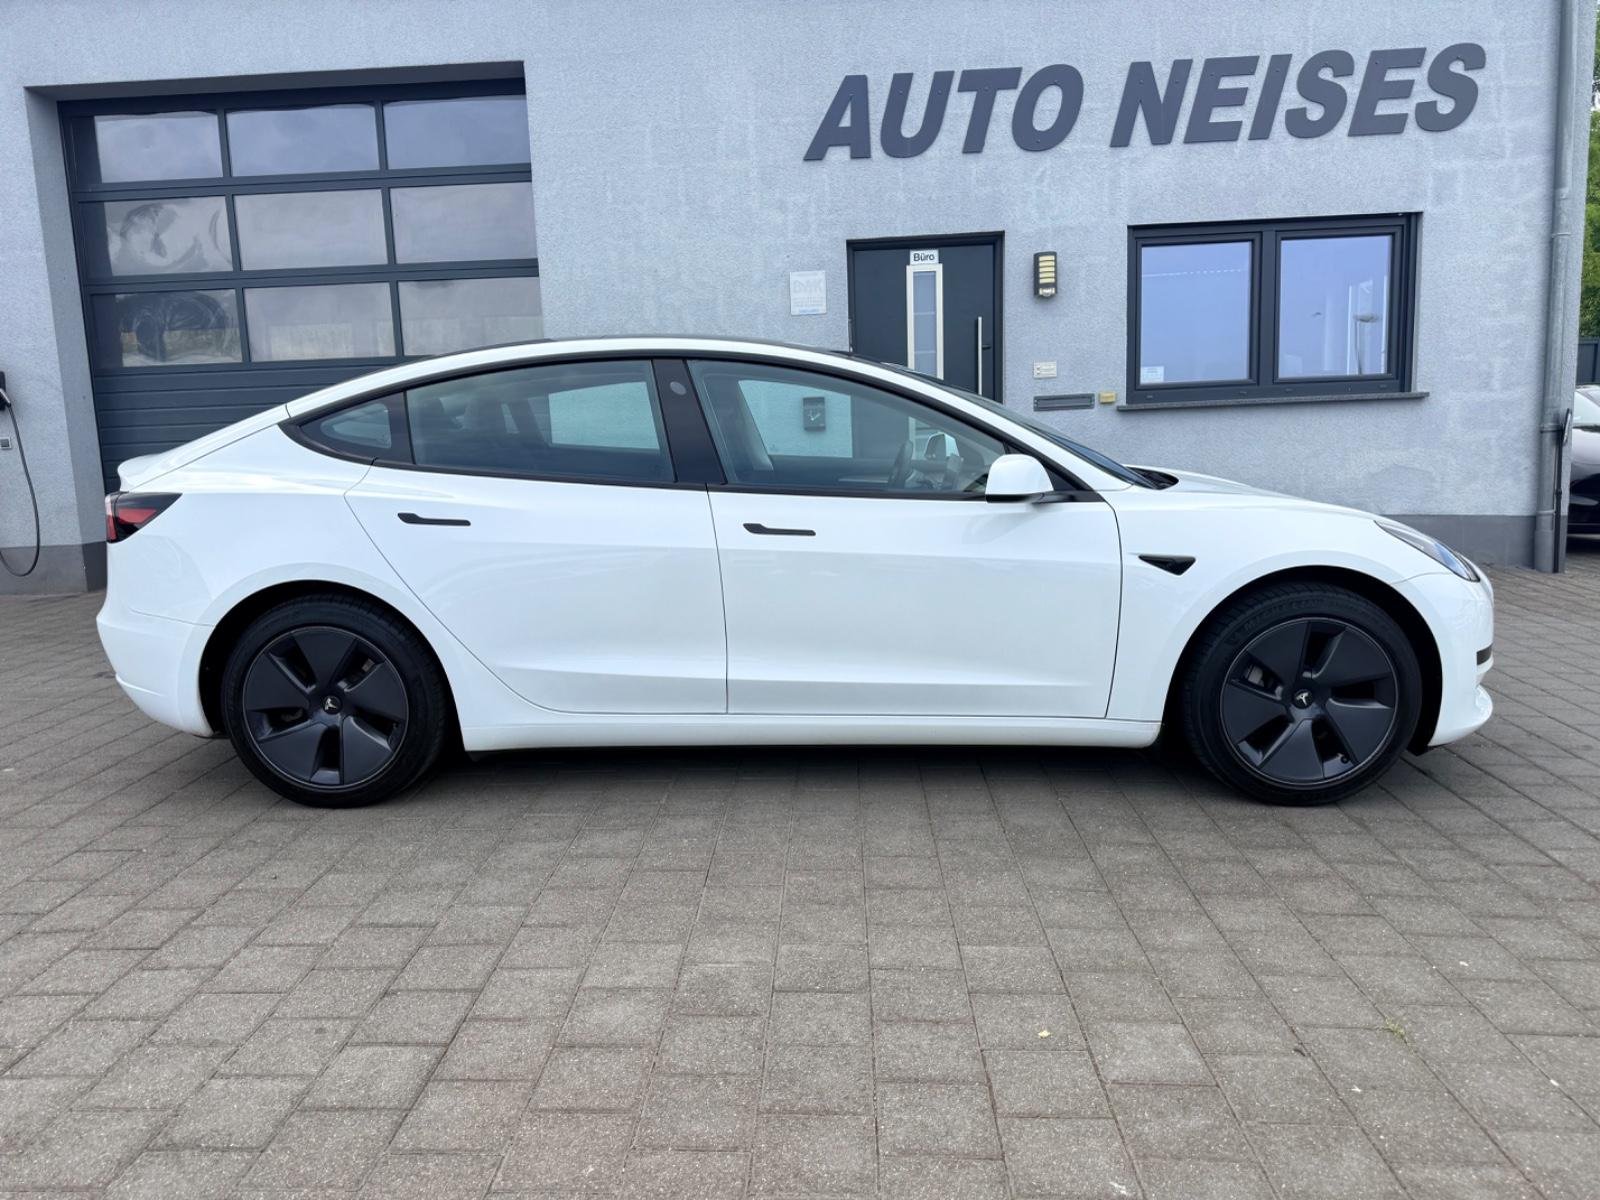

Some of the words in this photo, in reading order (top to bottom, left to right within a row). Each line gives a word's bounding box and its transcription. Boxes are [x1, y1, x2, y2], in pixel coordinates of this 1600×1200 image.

[803, 64, 1085, 162] AUTO
[1109, 43, 1487, 148] NEISES
[913, 252, 935, 261] Büro
